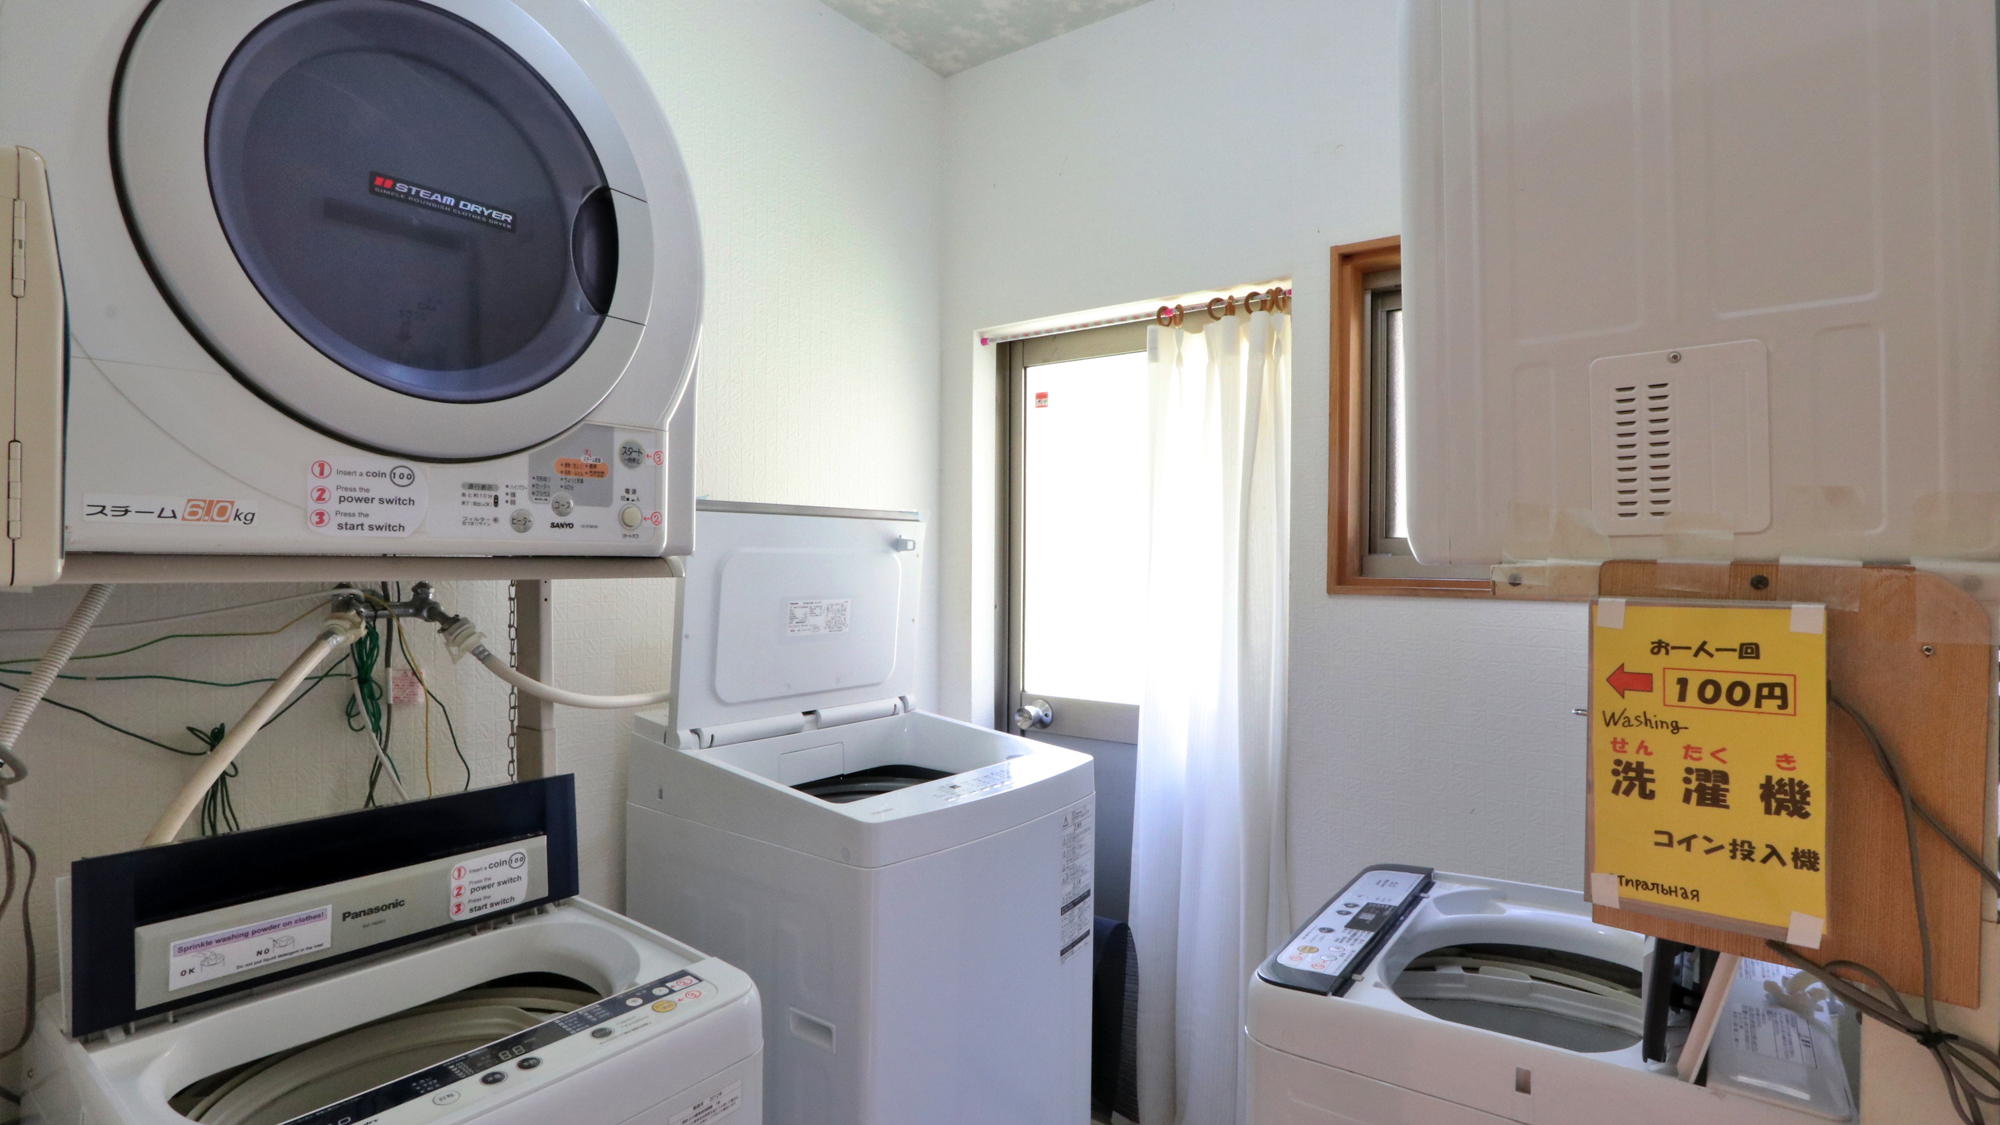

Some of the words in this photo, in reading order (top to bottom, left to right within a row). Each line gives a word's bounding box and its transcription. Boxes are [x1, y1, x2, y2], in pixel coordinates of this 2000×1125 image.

[375, 187, 404, 200] SIMPLE
[453, 208, 486, 222] CLOTHES
[488, 219, 512, 228] DRYER
[395, 182, 456, 206] STEAM
[459, 200, 513, 223] DRYER
[336, 468, 356, 476] Insert
[366, 470, 387, 478] coin
[338, 495, 376, 504] power
[378, 496, 415, 506] switch
[554, 501, 572, 510] コース
[337, 522, 364, 532] start
[368, 523, 405, 532] switch
[512, 517, 532, 526] ヒーター
[1650, 639, 1761, 660] お一人一回
[1676, 676, 1790, 710] 100円
[1602, 709, 1689, 734] Washing
[1654, 829, 1821, 873] コイン投入機
[488, 860, 508, 870] coin
[470, 882, 496, 894] power
[497, 875, 522, 886] switch
[342, 898, 406, 922] Panasonic
[469, 902, 488, 914] start
[490, 896, 515, 908] switch
[177, 940, 213, 954] Sprinkle
[214, 932, 250, 944] washing
[251, 923, 281, 936] powder
[294, 912, 324, 924] clothes!
